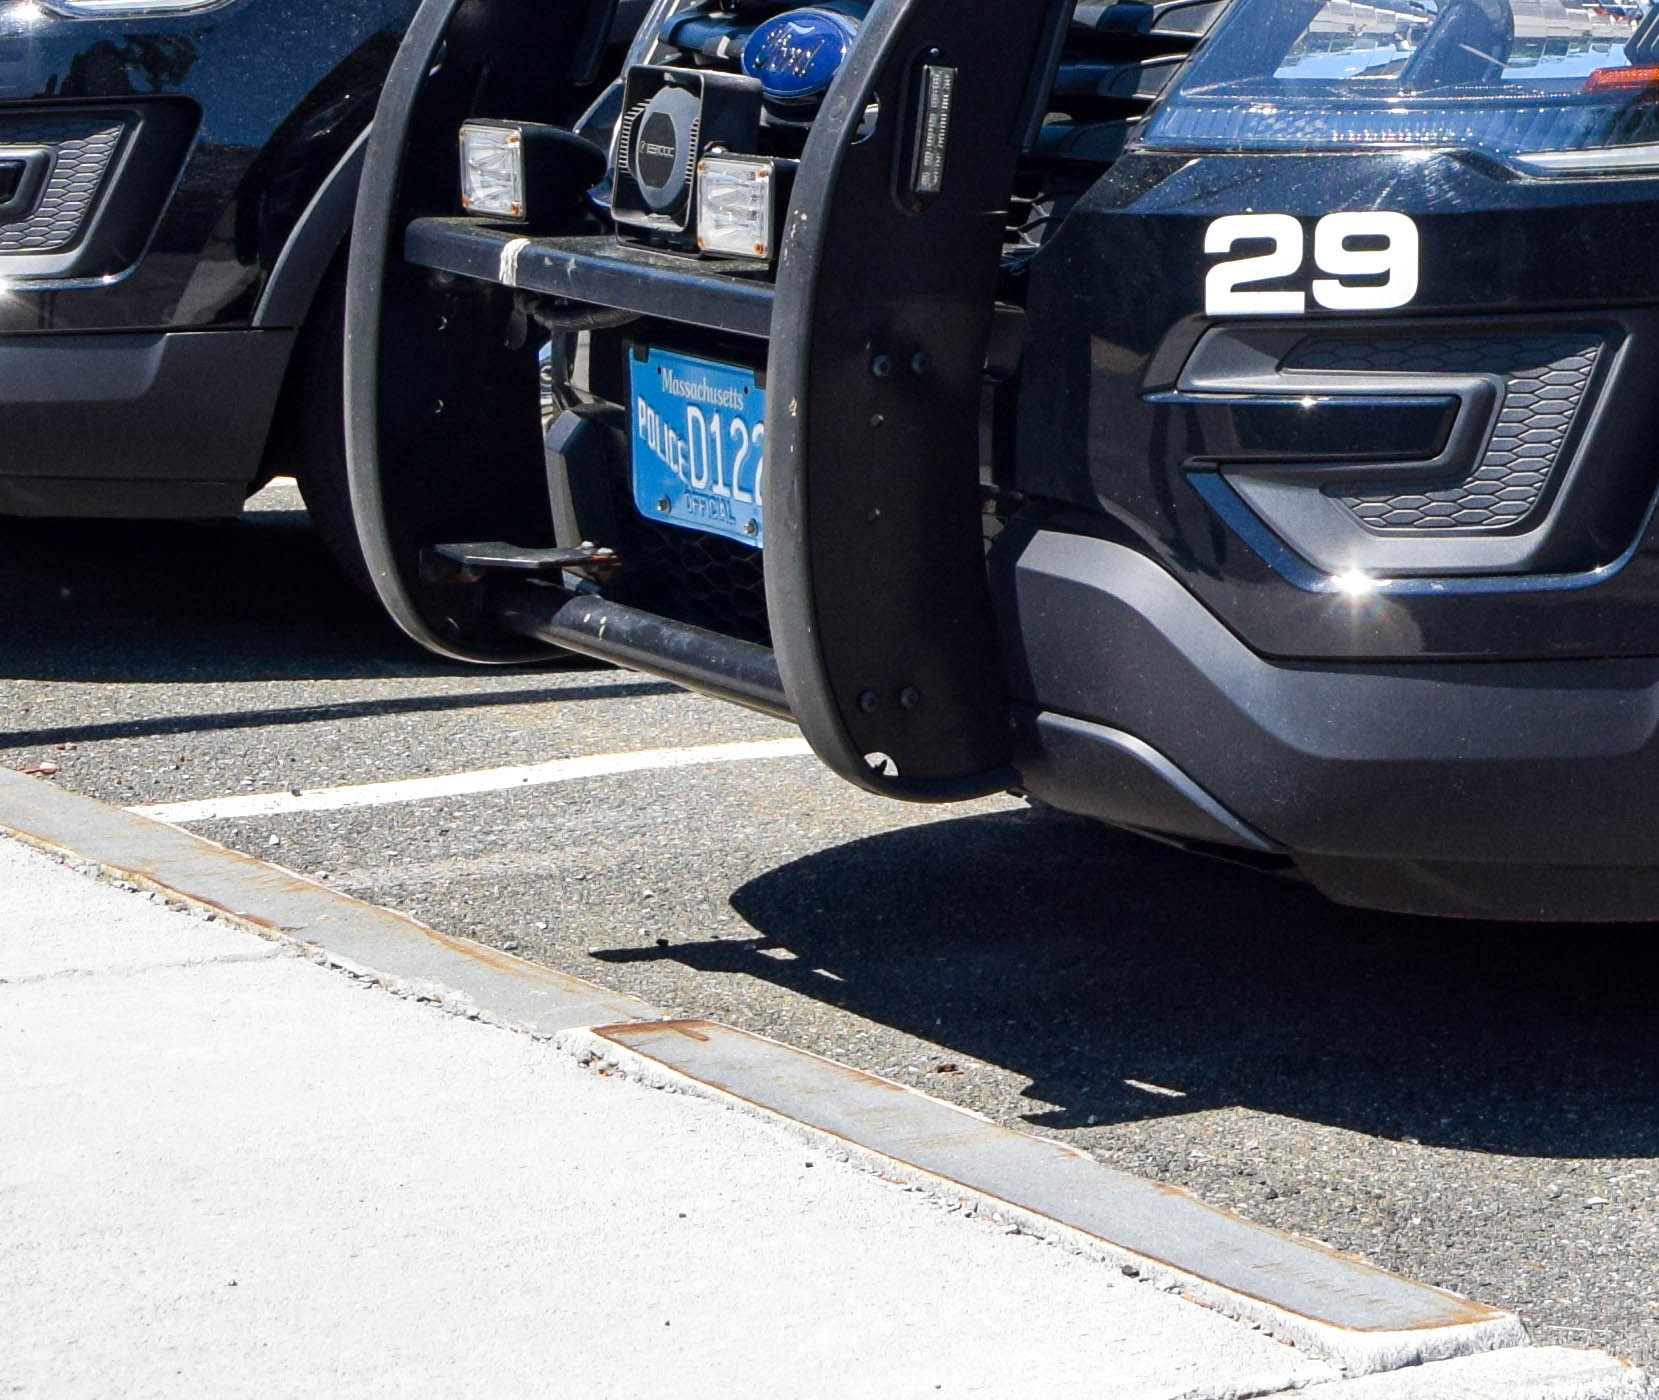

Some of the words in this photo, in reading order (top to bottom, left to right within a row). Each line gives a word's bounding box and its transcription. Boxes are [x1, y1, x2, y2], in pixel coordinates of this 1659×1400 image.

[1203, 209, 1420, 317] 29
[660, 367, 746, 411] Massachusetts
[637, 396, 690, 484] POLICE
[683, 491, 736, 526] OFFICIAL
